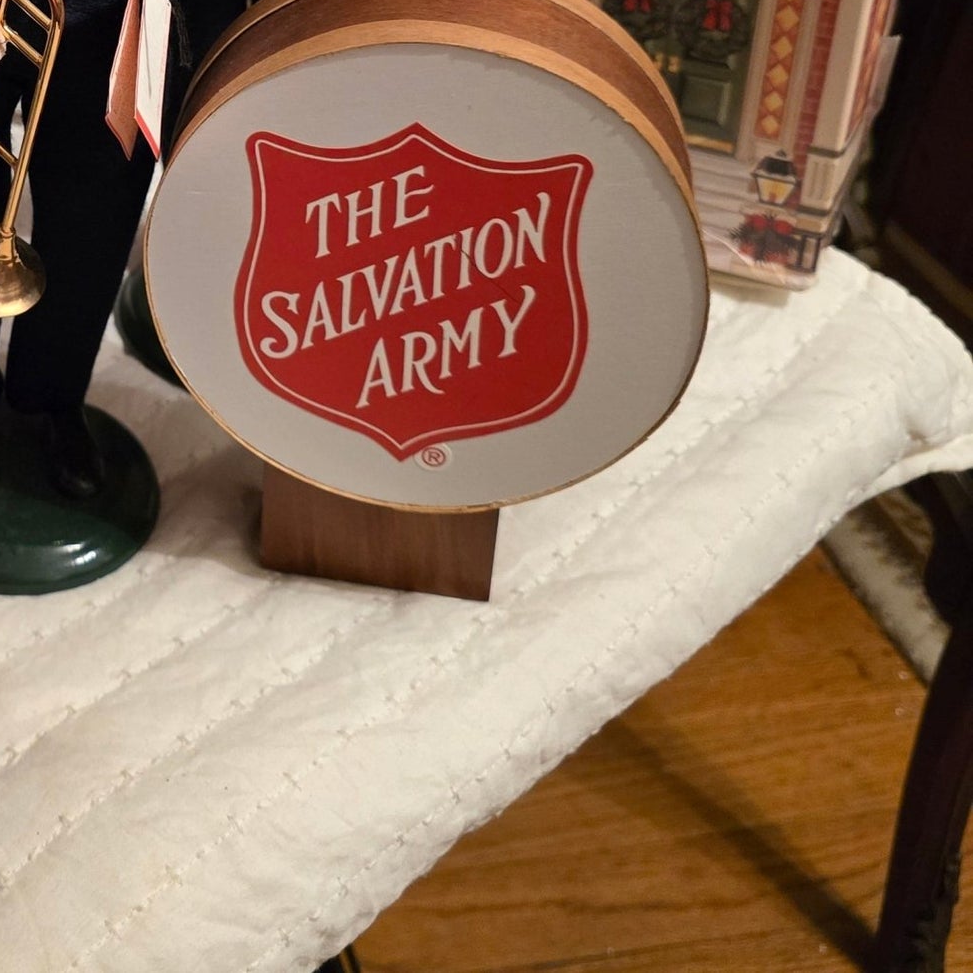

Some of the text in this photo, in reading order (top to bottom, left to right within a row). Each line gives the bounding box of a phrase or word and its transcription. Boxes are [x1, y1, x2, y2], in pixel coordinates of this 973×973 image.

[305, 165, 434, 259] THE
[259, 192, 551, 359] SALVATION
[355, 285, 536, 409] ARMY
